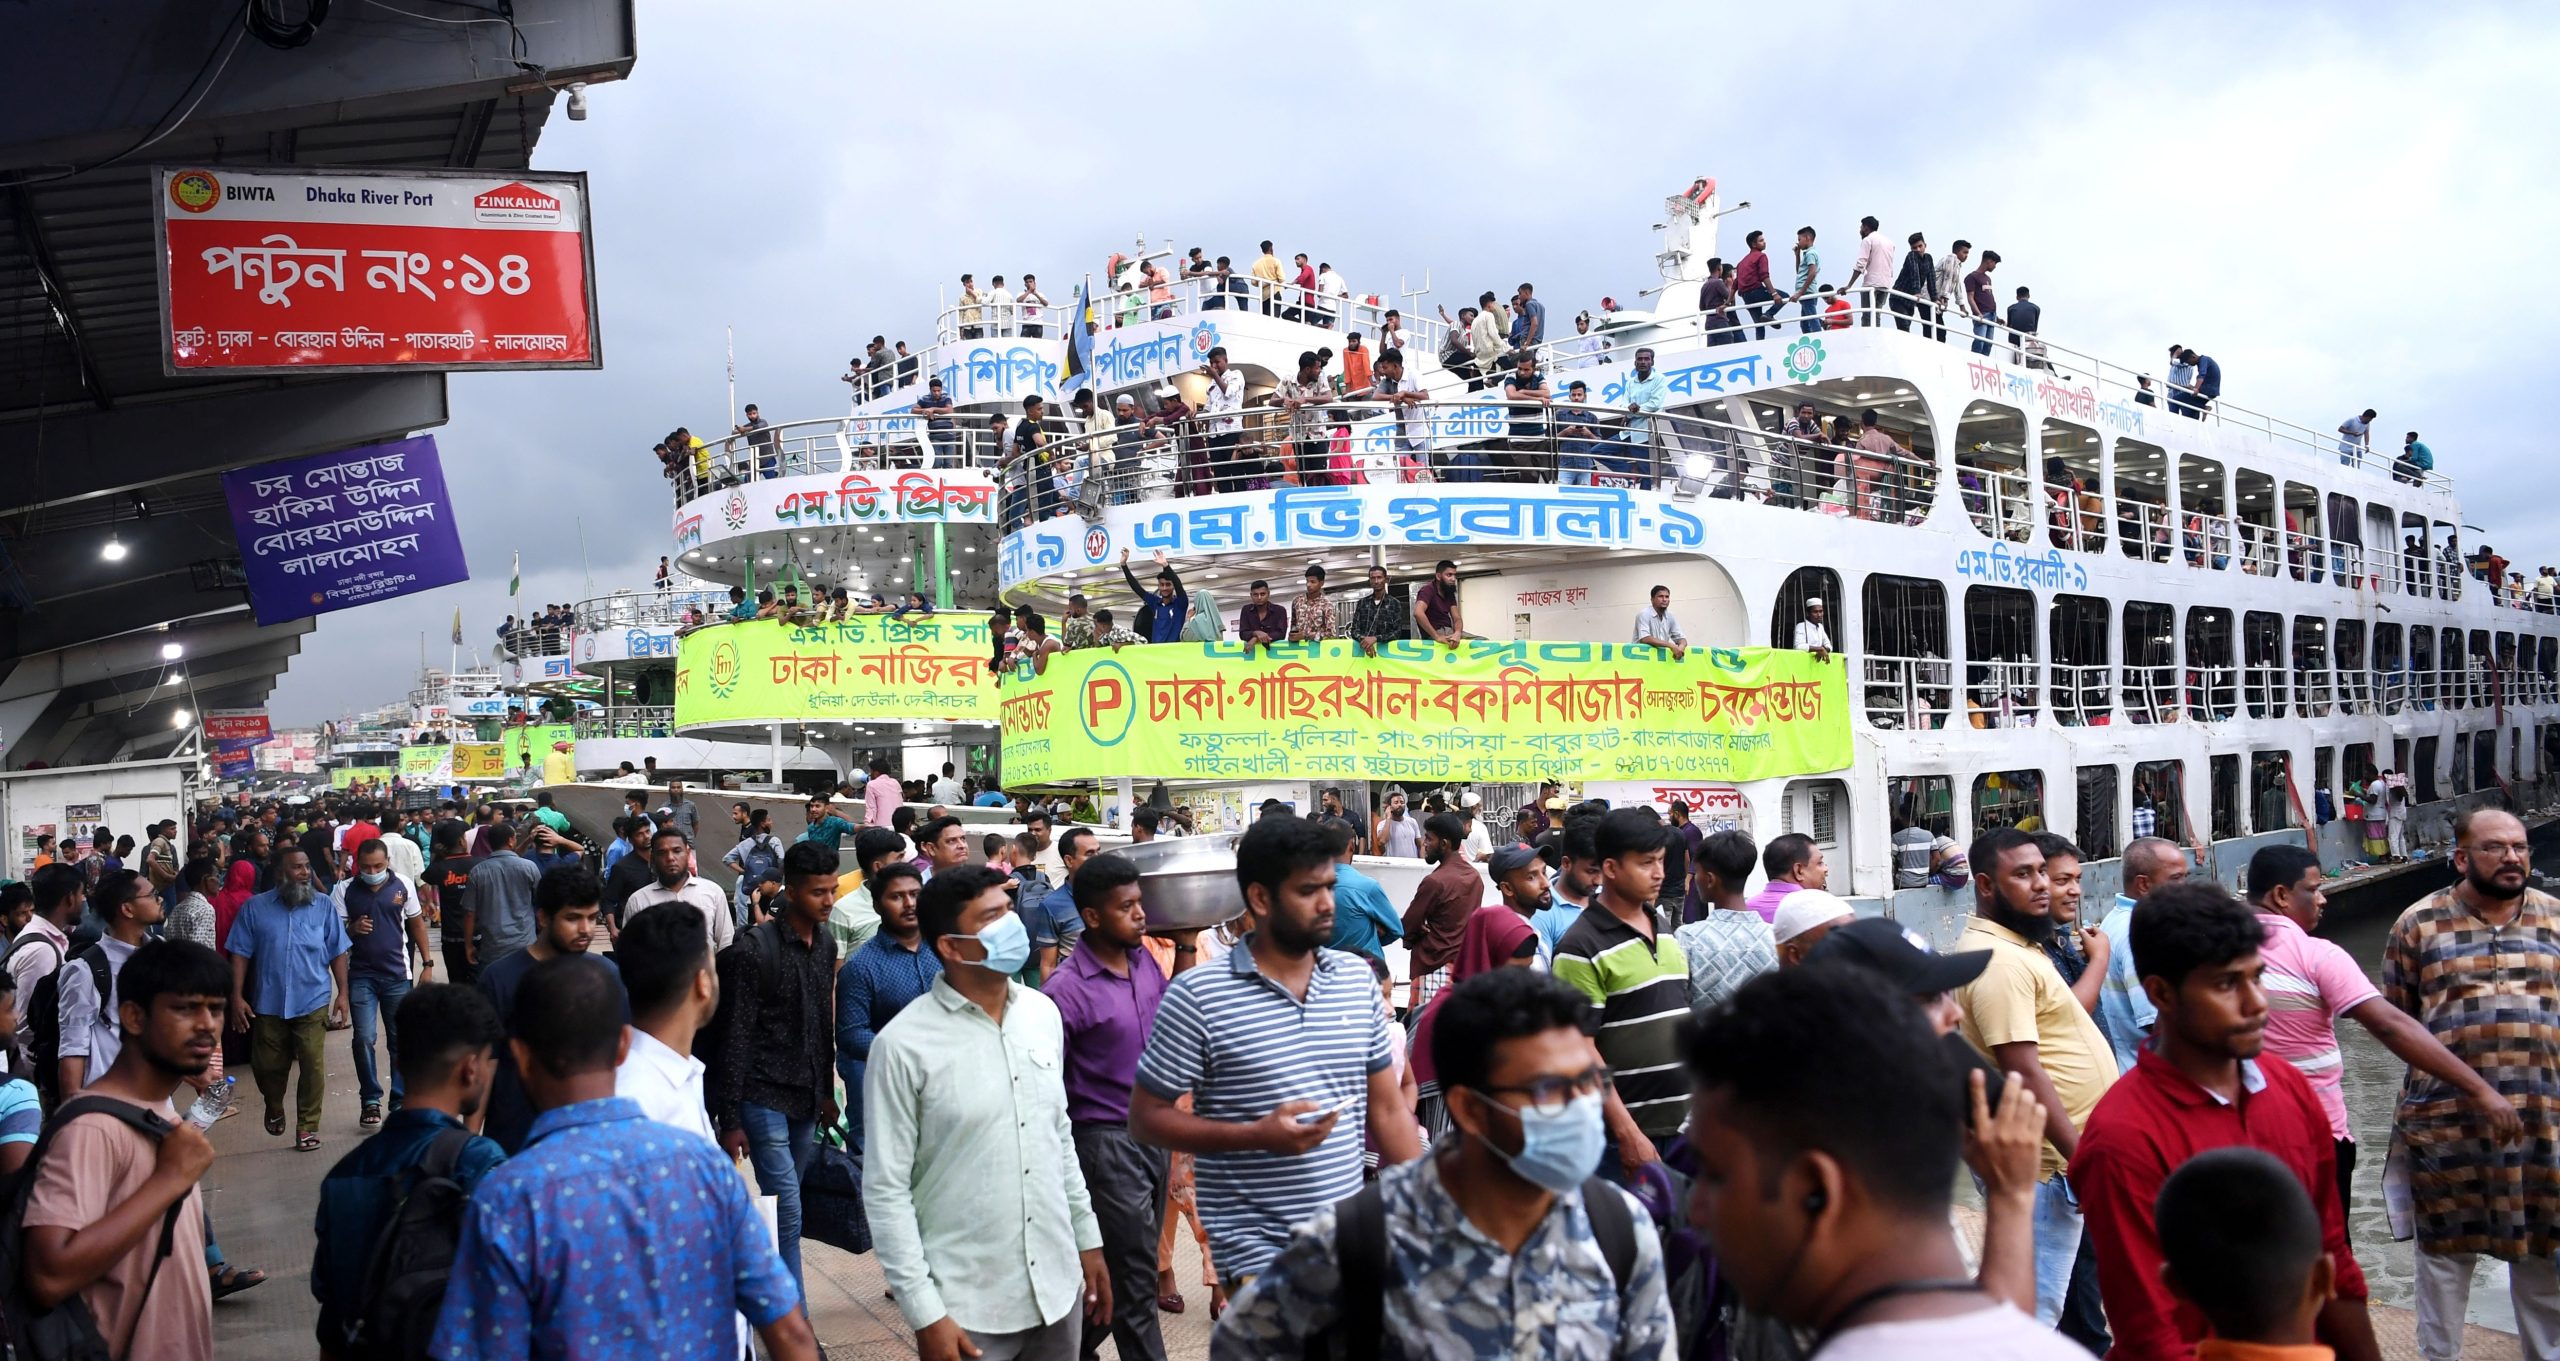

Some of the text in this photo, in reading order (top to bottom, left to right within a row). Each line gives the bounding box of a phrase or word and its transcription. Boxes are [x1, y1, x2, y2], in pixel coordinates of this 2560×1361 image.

[226, 185, 275, 202] BIWTA
[306, 186, 434, 207] Dhaka River Port
[479, 196, 556, 209] ZINKALUM
[202, 233, 532, 309] পন্টুন নং:১৪
[217, 330, 253, 348] ঢাকা
[274, 331, 337, 349] বোরহান
[341, 326, 385, 349] উদ্দিন
[404, 328, 475, 350] পাতারহাট
[494, 333, 567, 352] লালমোহন
[964, 346, 1057, 401] শিপিং
[1967, 359, 2001, 398] ঢাকা
[250, 453, 406, 498] চর মোন্তাজ
[248, 477, 422, 527] হাকিম উদ্দিন
[253, 502, 435, 556] বোরহানউদ্দিন
[279, 533, 420, 576] লালমোহন
[1517, 587, 1588, 606] নামাজের স্থান
[770, 650, 842, 688] ঢাকা
[808, 690, 978, 709] ধুলিয়া দেউলা দেবীরচর
[1088, 678, 1122, 727] P
[1146, 672, 1226, 721] ঢাকা
[1239, 662, 1422, 721] গাছিরখাল
[1429, 666, 1644, 723] বকশিবাজার
[1696, 675, 1822, 725] চরমোন্তাজ
[1179, 730, 1269, 753] ফতুল্লা
[1281, 724, 1358, 750] ধুলিয়া
[1631, 729, 1724, 751] বাংলাবাজার
[1184, 748, 1289, 774] গাইনখালী
[1362, 749, 1449, 776] সুইচগেট
[1466, 755, 1493, 780] পূর্ব
[1499, 759, 1528, 777] চর
